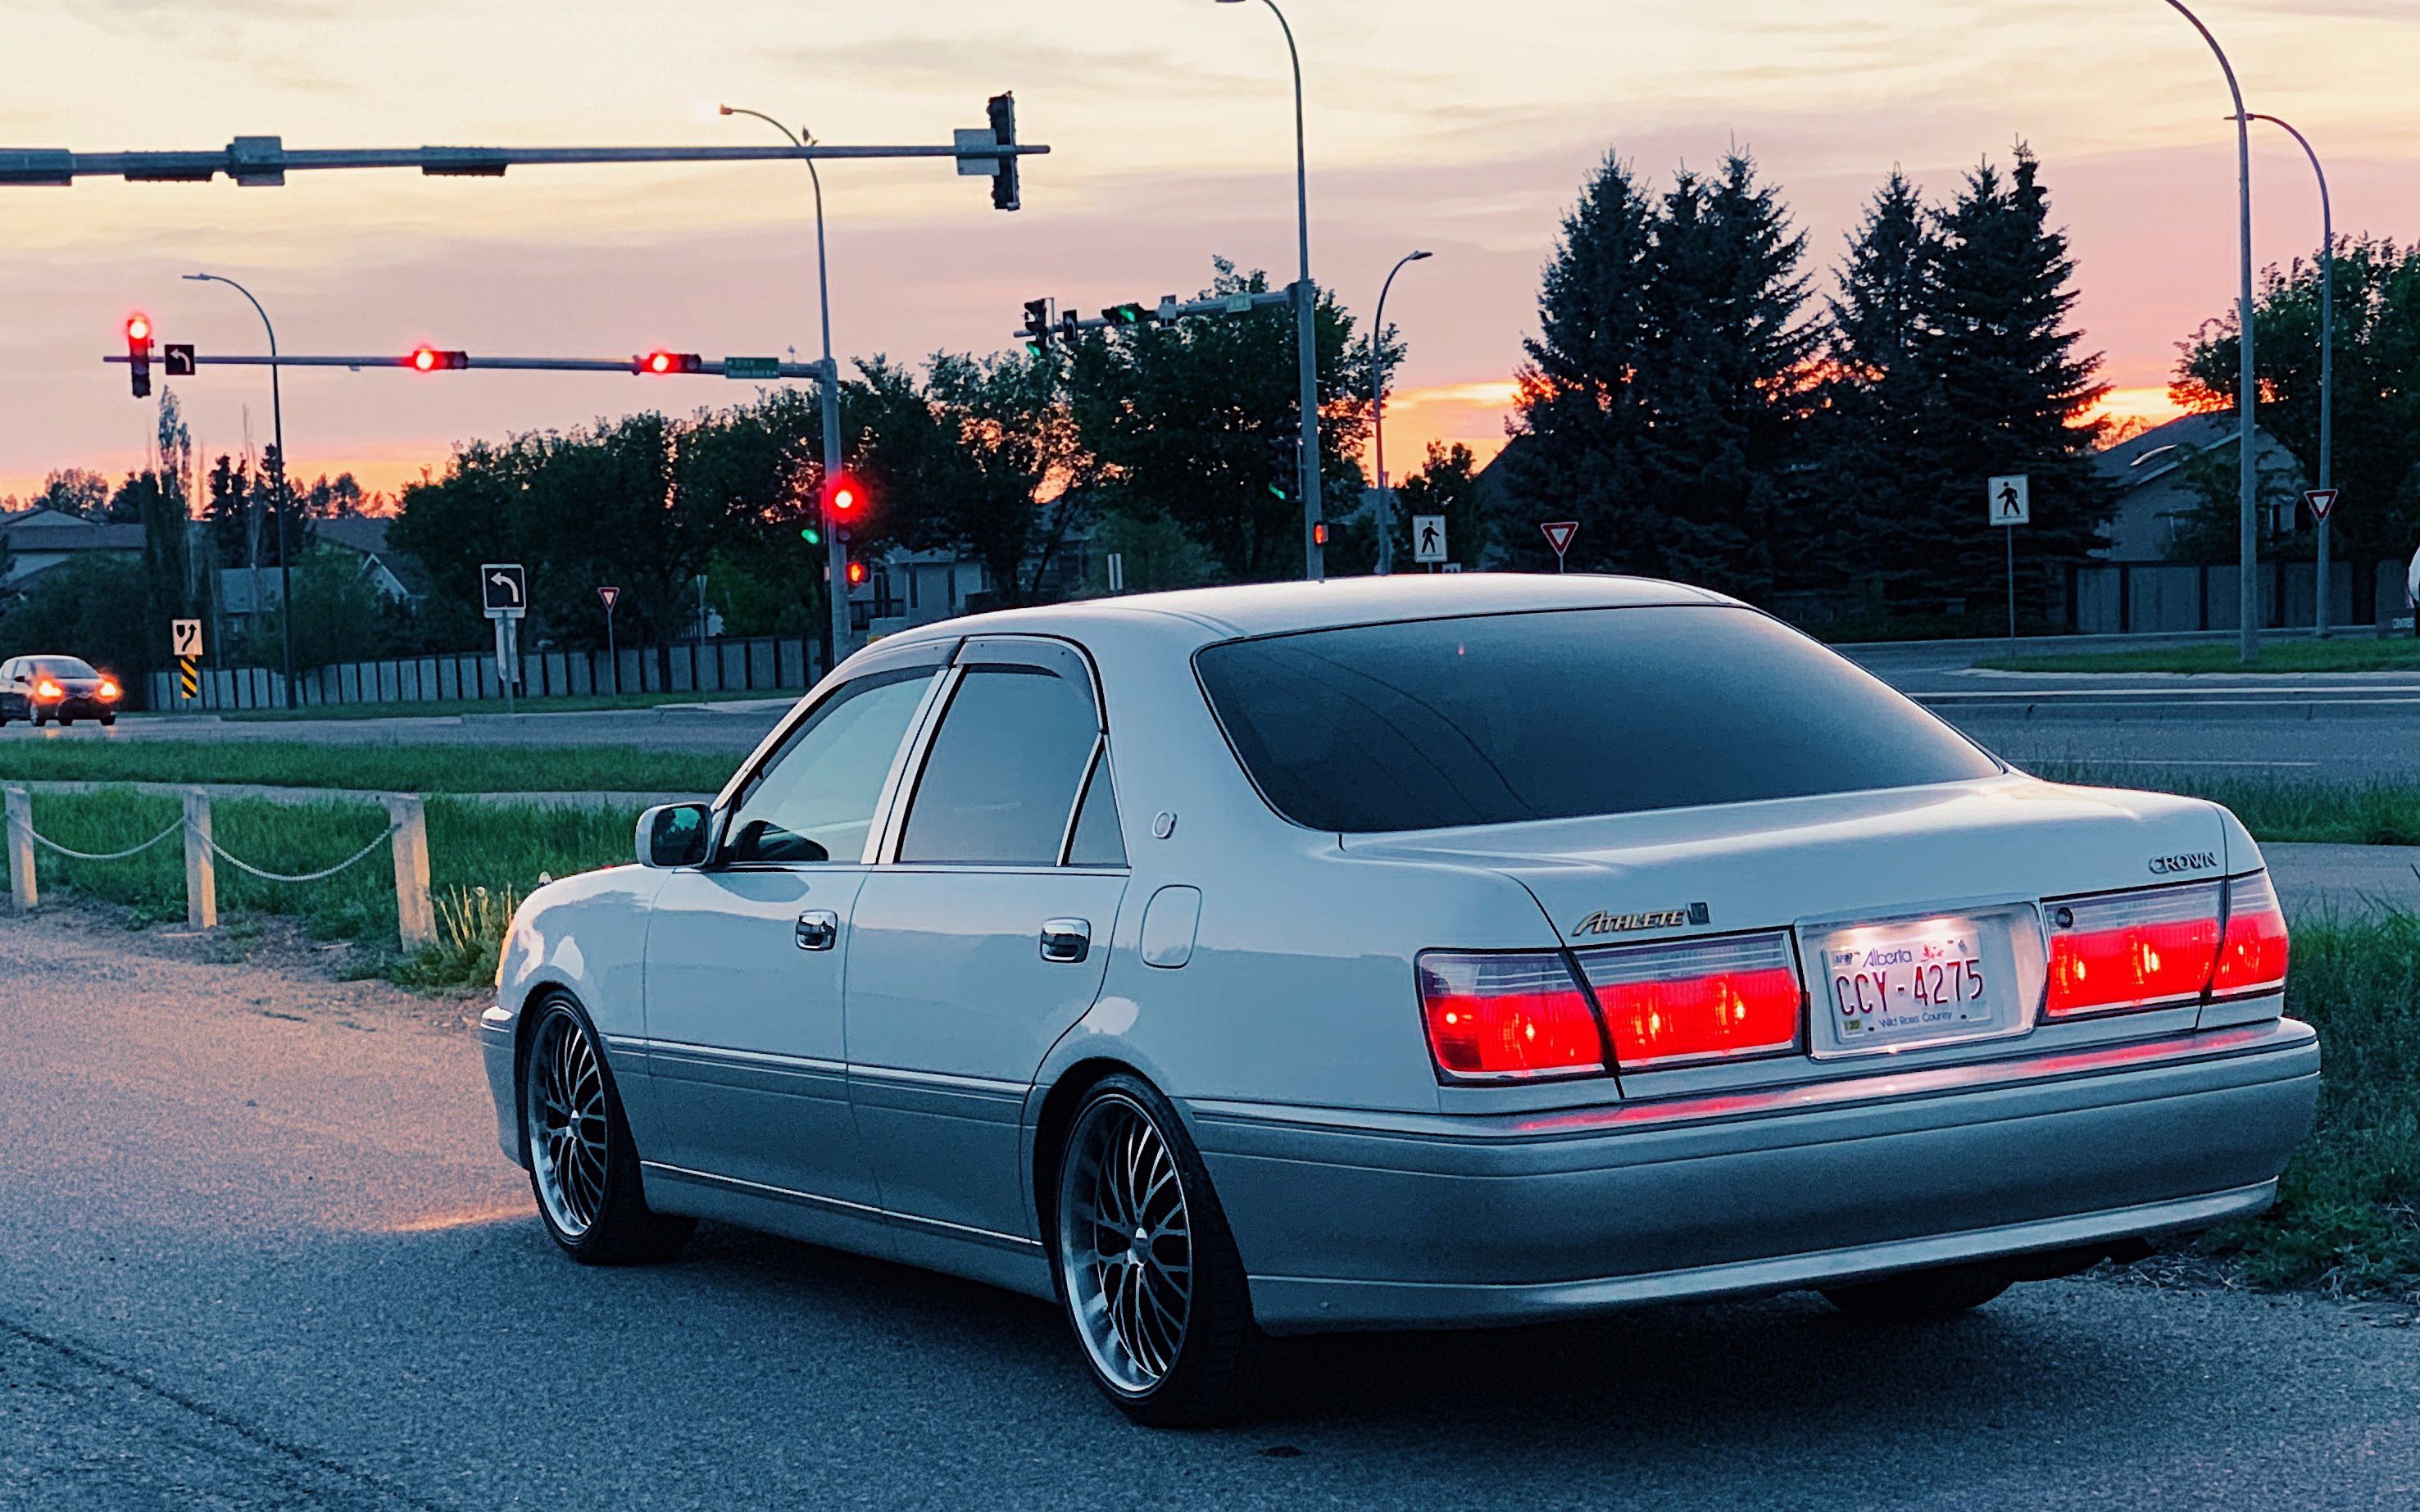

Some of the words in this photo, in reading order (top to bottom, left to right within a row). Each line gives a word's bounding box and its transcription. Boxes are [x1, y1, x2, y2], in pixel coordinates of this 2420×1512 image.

[2148, 851, 2218, 874] CROWN
[1571, 909, 1685, 937] ATHLETE
[1862, 947, 1913, 968] Alberta
[1835, 958, 1983, 1016] CCY-4275
[1877, 1017, 1898, 1027] Wild
[1900, 1015, 1919, 1024] Rose
[1922, 1011, 1953, 1023] County
